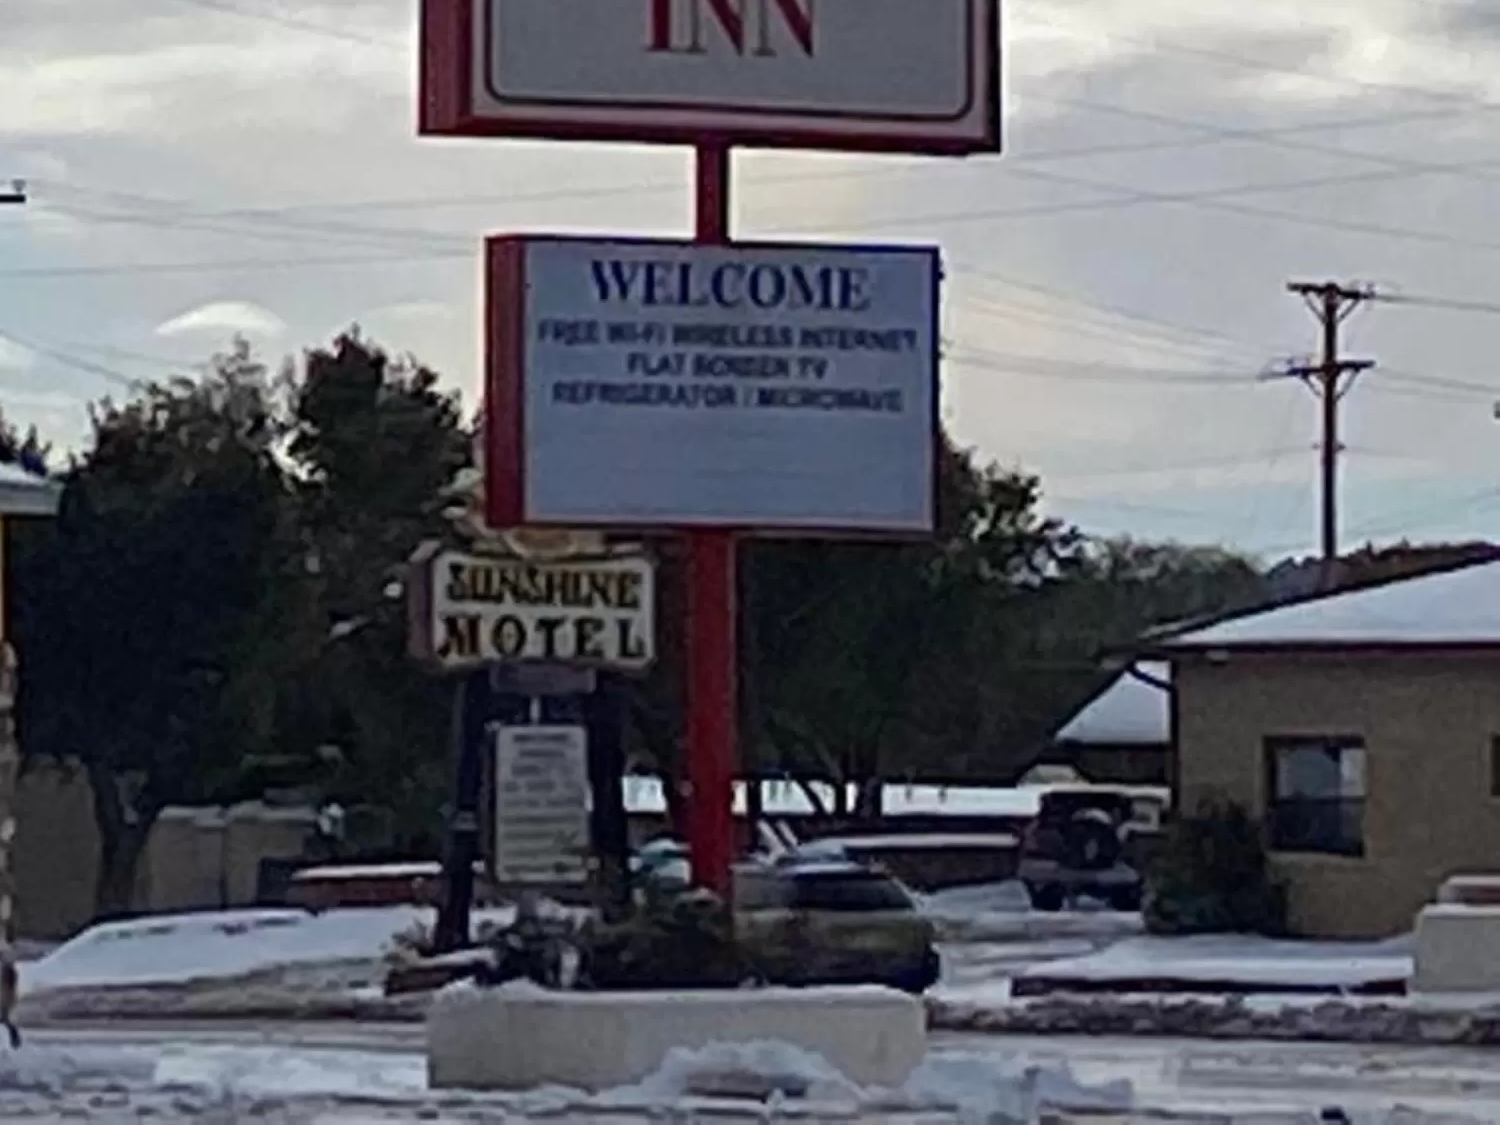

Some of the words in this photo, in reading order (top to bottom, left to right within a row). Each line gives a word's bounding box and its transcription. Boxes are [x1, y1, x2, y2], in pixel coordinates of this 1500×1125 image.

[591, 259, 871, 311] WELCOME
[537, 319, 599, 346] FREE
[607, 321, 665, 348] WI-FI
[672, 323, 793, 349] WIRELESS
[801, 327, 918, 352] INTERNET
[627, 351, 687, 376] FLAT
[694, 354, 789, 378] SCREEN
[797, 356, 829, 380] TV
[552, 380, 737, 409] REFRIGERATOR
[758, 386, 905, 412] MICROWAVE
[446, 562, 643, 610] SUNSHINE
[438, 613, 646, 660] MOTEL
